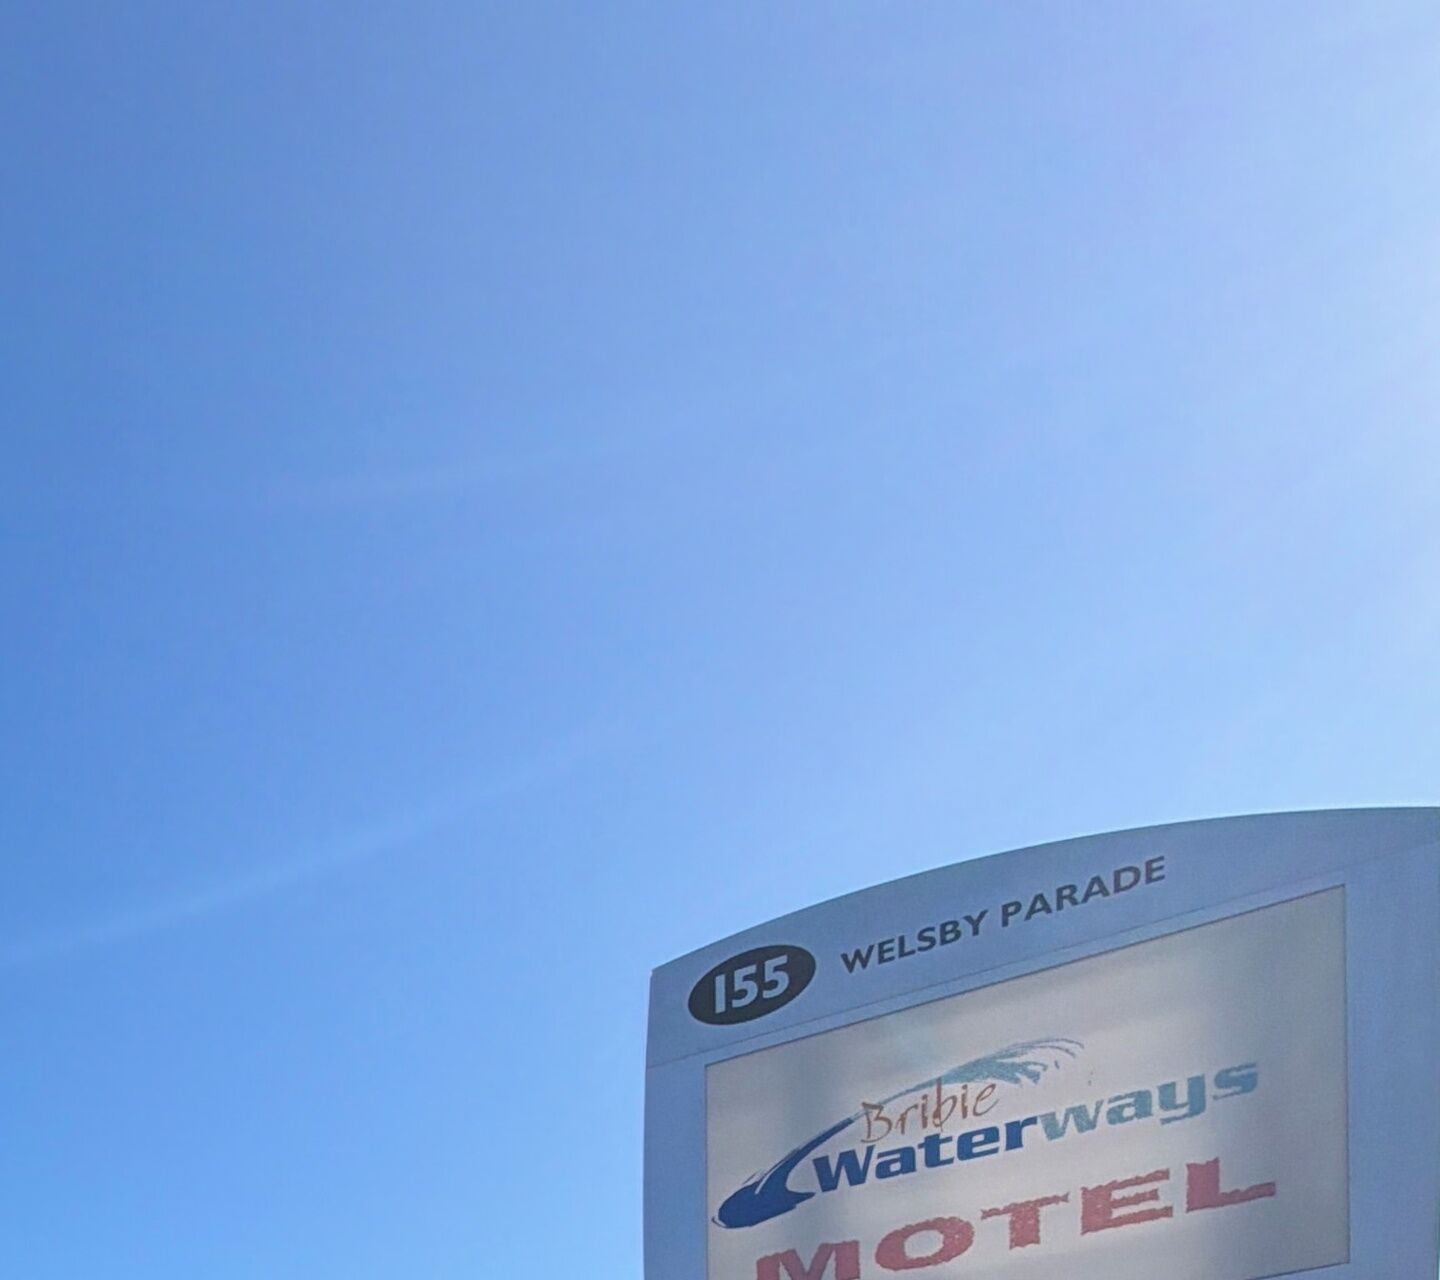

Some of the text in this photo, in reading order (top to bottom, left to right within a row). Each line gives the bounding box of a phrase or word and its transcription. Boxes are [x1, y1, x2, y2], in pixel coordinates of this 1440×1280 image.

[714, 856, 1165, 1013] 155 WELSBY PARADE
[812, 1062, 1258, 1193] Waterways
[862, 1078, 1000, 1143] Bribie
